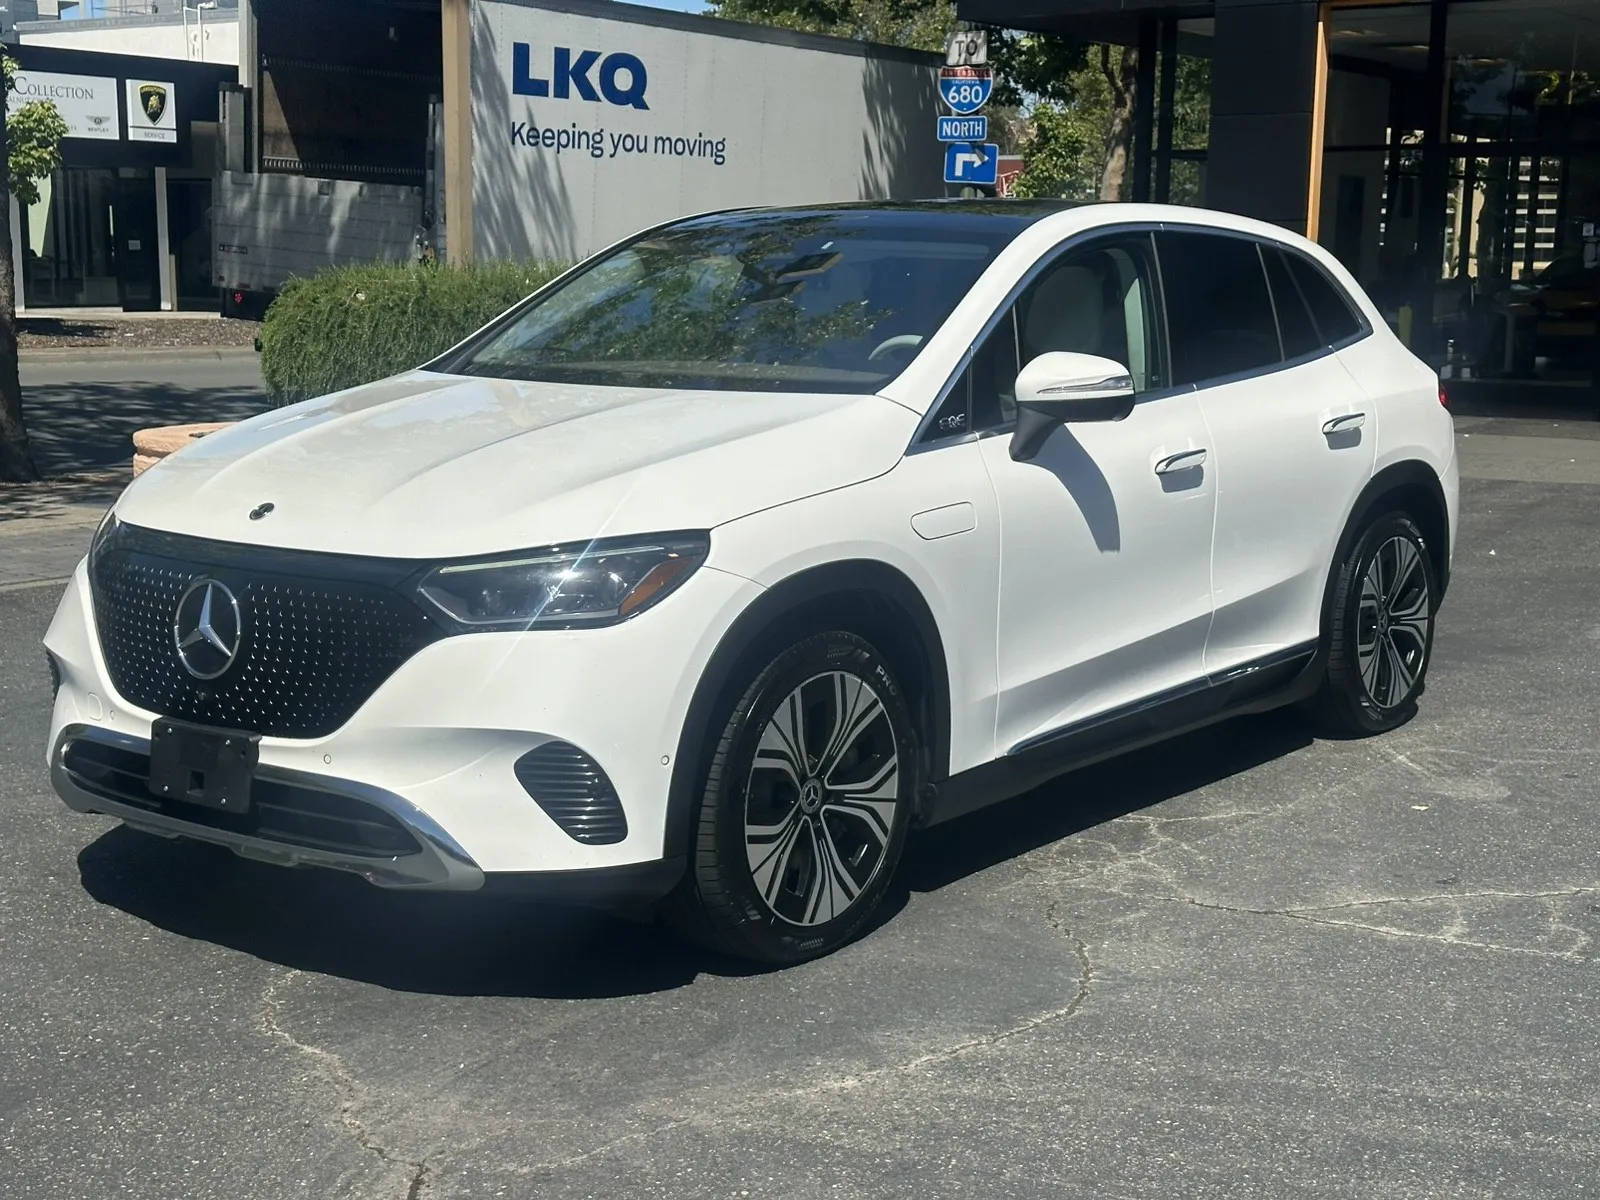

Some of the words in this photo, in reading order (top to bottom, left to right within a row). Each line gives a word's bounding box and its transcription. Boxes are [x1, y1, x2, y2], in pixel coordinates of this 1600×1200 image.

[955, 40, 977, 56] TO
[512, 41, 650, 110] LKQ
[948, 85, 983, 103] 680
[144, 131, 165, 139] SERVICE
[942, 121, 982, 136] NORTH
[511, 122, 604, 158] Keeping
[609, 132, 648, 158] you
[654, 132, 726, 165] moving
